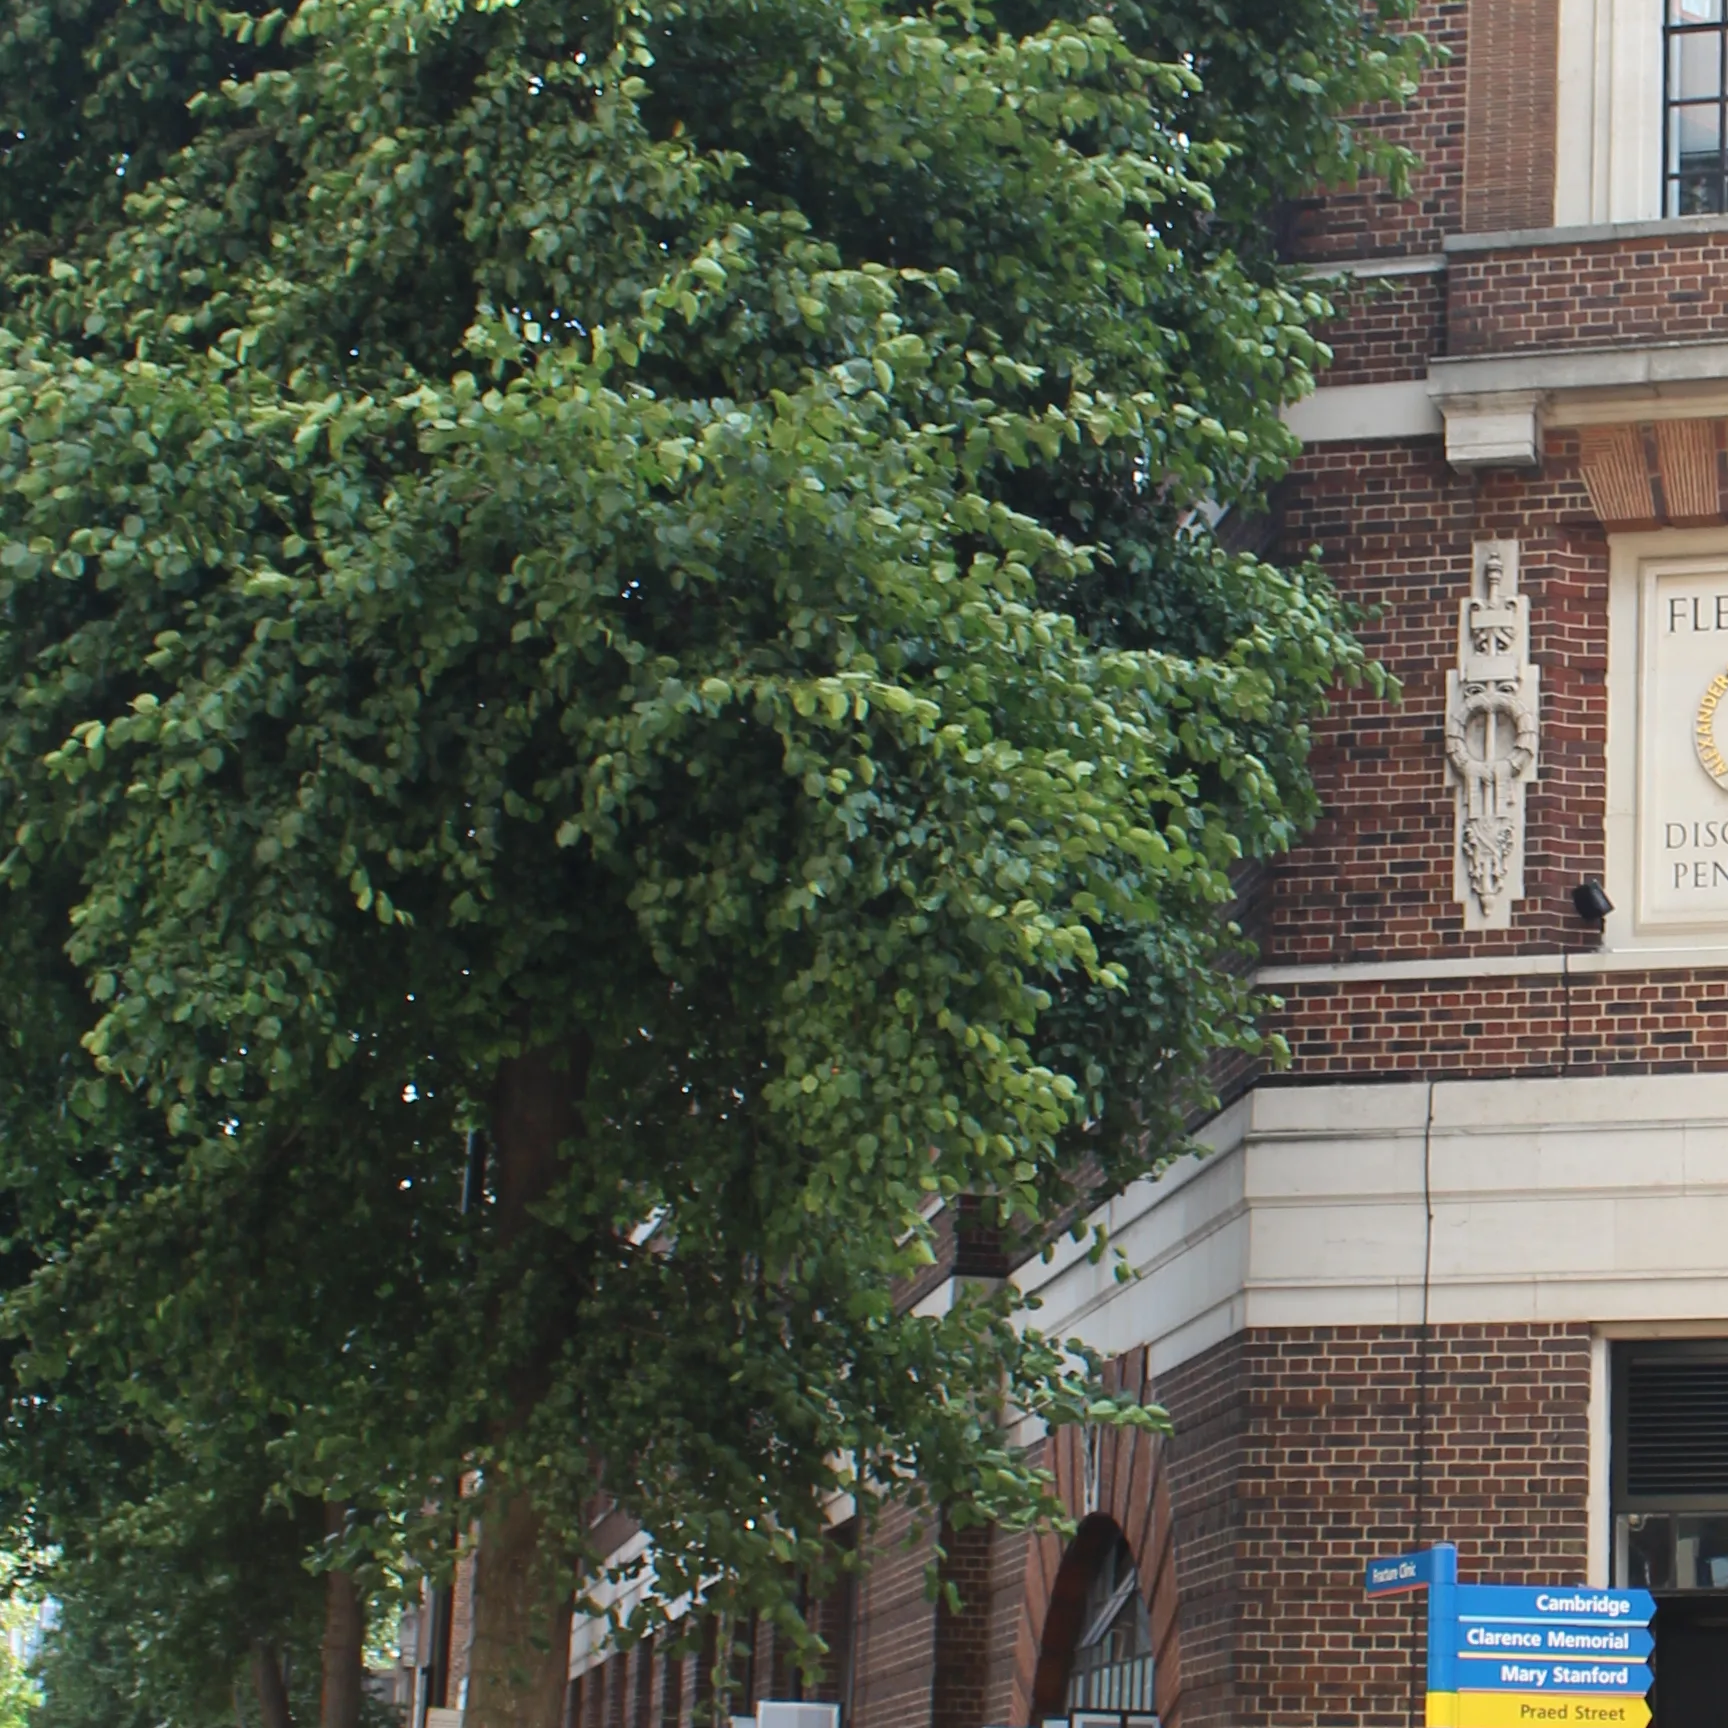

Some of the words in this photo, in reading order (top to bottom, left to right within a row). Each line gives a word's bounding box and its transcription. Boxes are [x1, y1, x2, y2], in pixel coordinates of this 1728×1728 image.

[1399, 1562, 1416, 1579] Clinic
[1536, 1594, 1631, 1616] Cambridge
[1466, 1628, 1541, 1647] Clarence
[1547, 1630, 1630, 1650] Memorial
[1501, 1665, 1547, 1686] Mary
[1553, 1666, 1629, 1685] Stanford
[1521, 1704, 1568, 1720] Praed
[1575, 1705, 1625, 1721] Street
